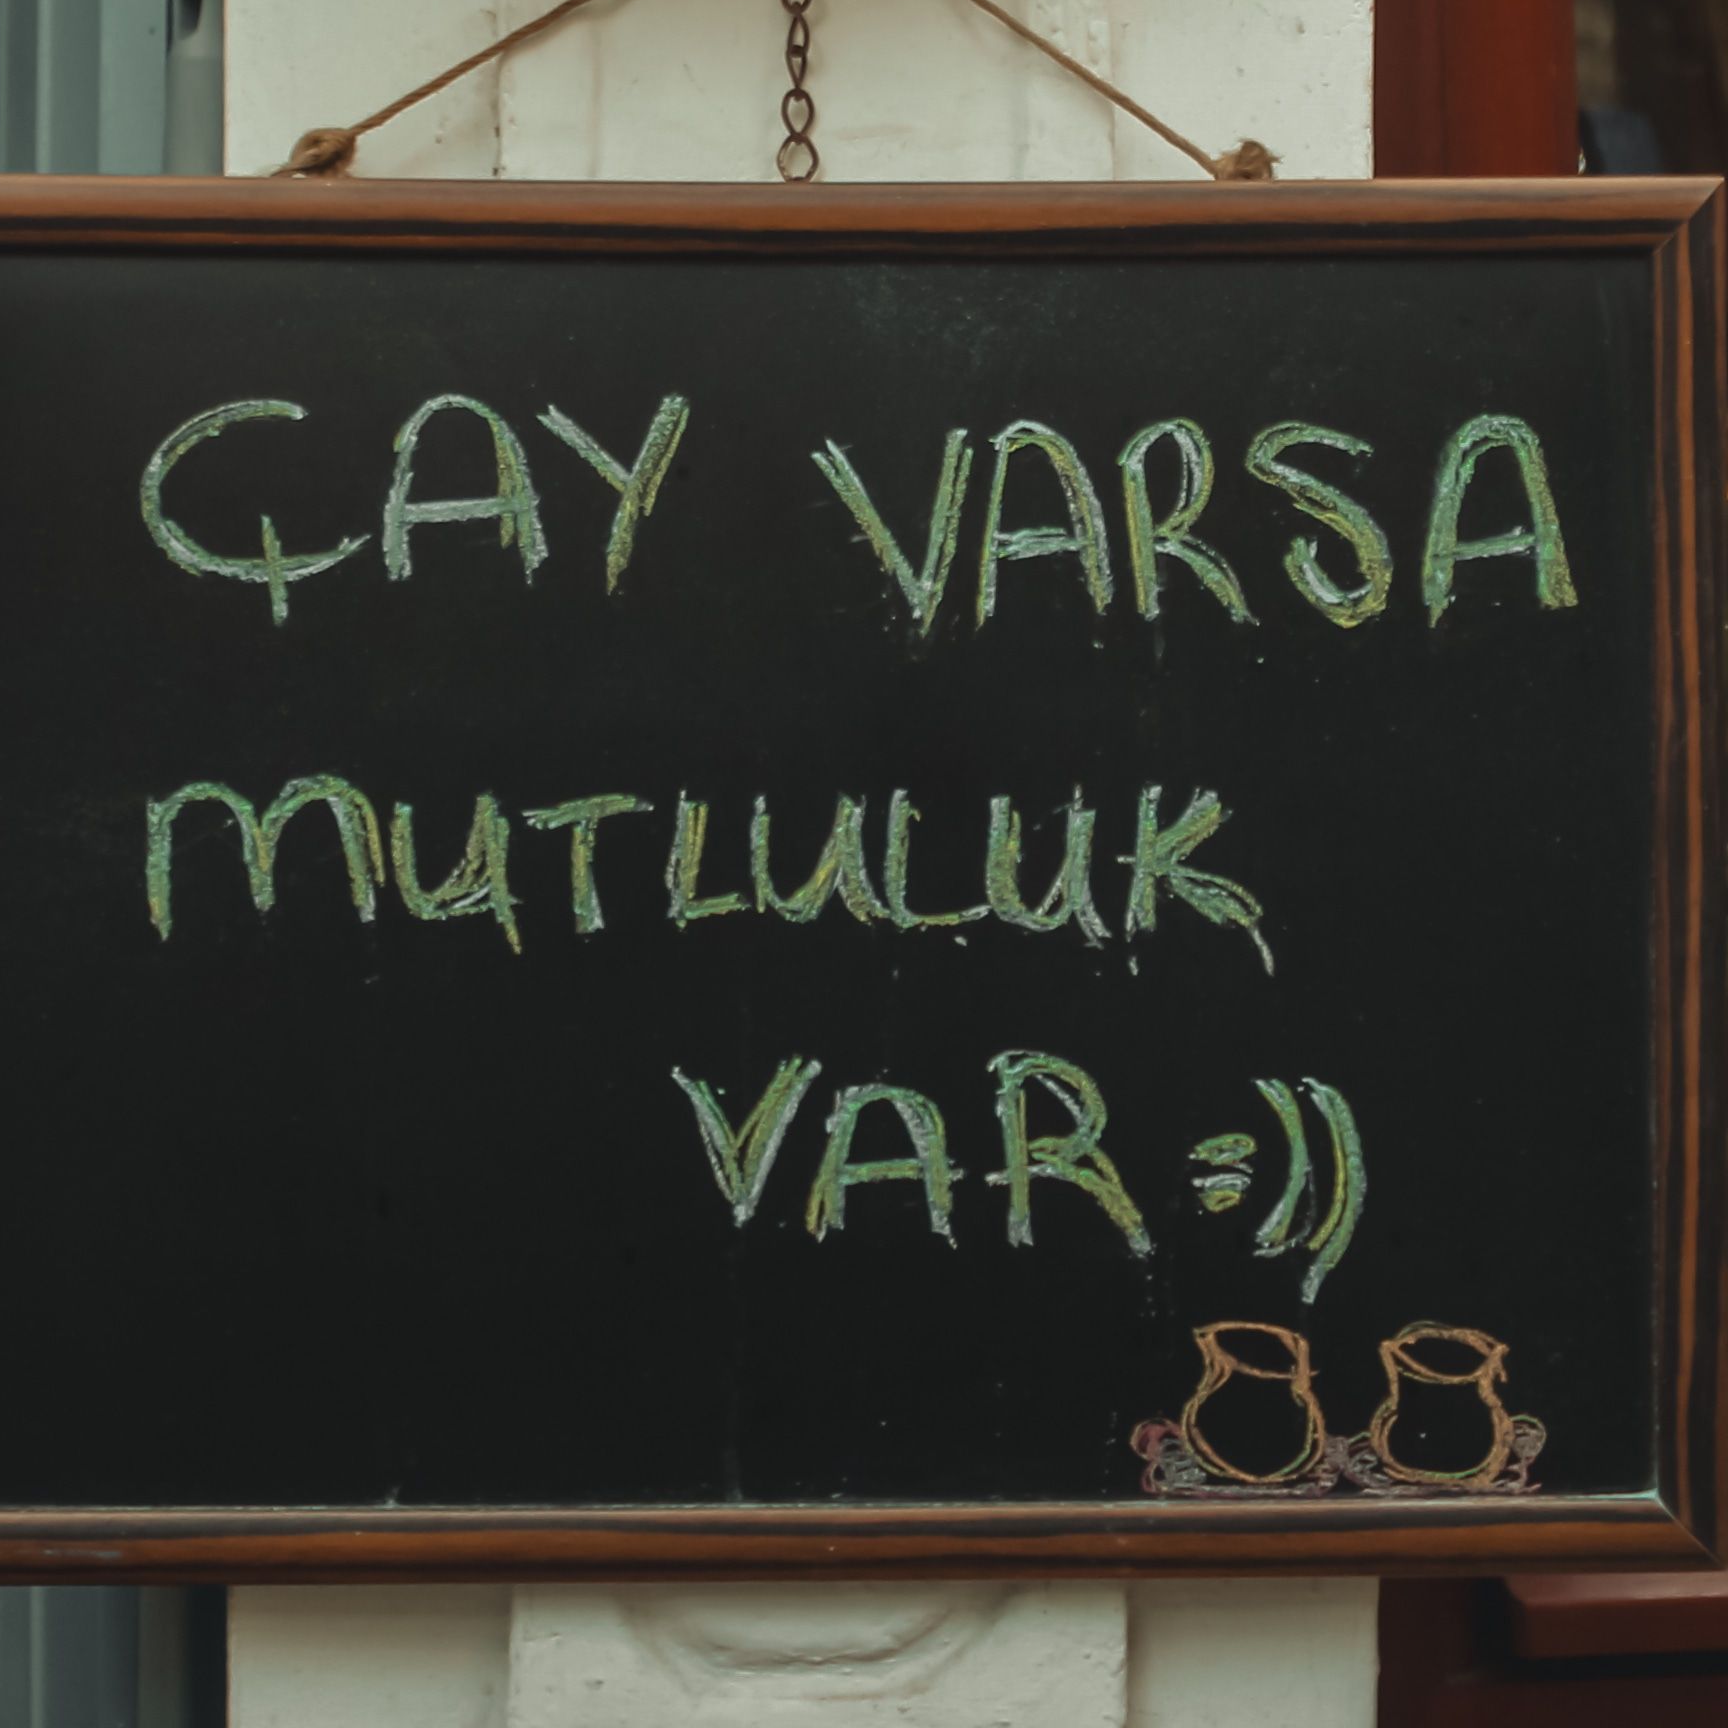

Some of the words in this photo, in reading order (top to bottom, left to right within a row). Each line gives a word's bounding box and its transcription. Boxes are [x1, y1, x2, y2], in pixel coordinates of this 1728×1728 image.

[140, 392, 691, 626] ÇAY
[811, 414, 1579, 636] VARSA
[145, 774, 1274, 976] MUTLULUK
[671, 1050, 1155, 1258] VAR
